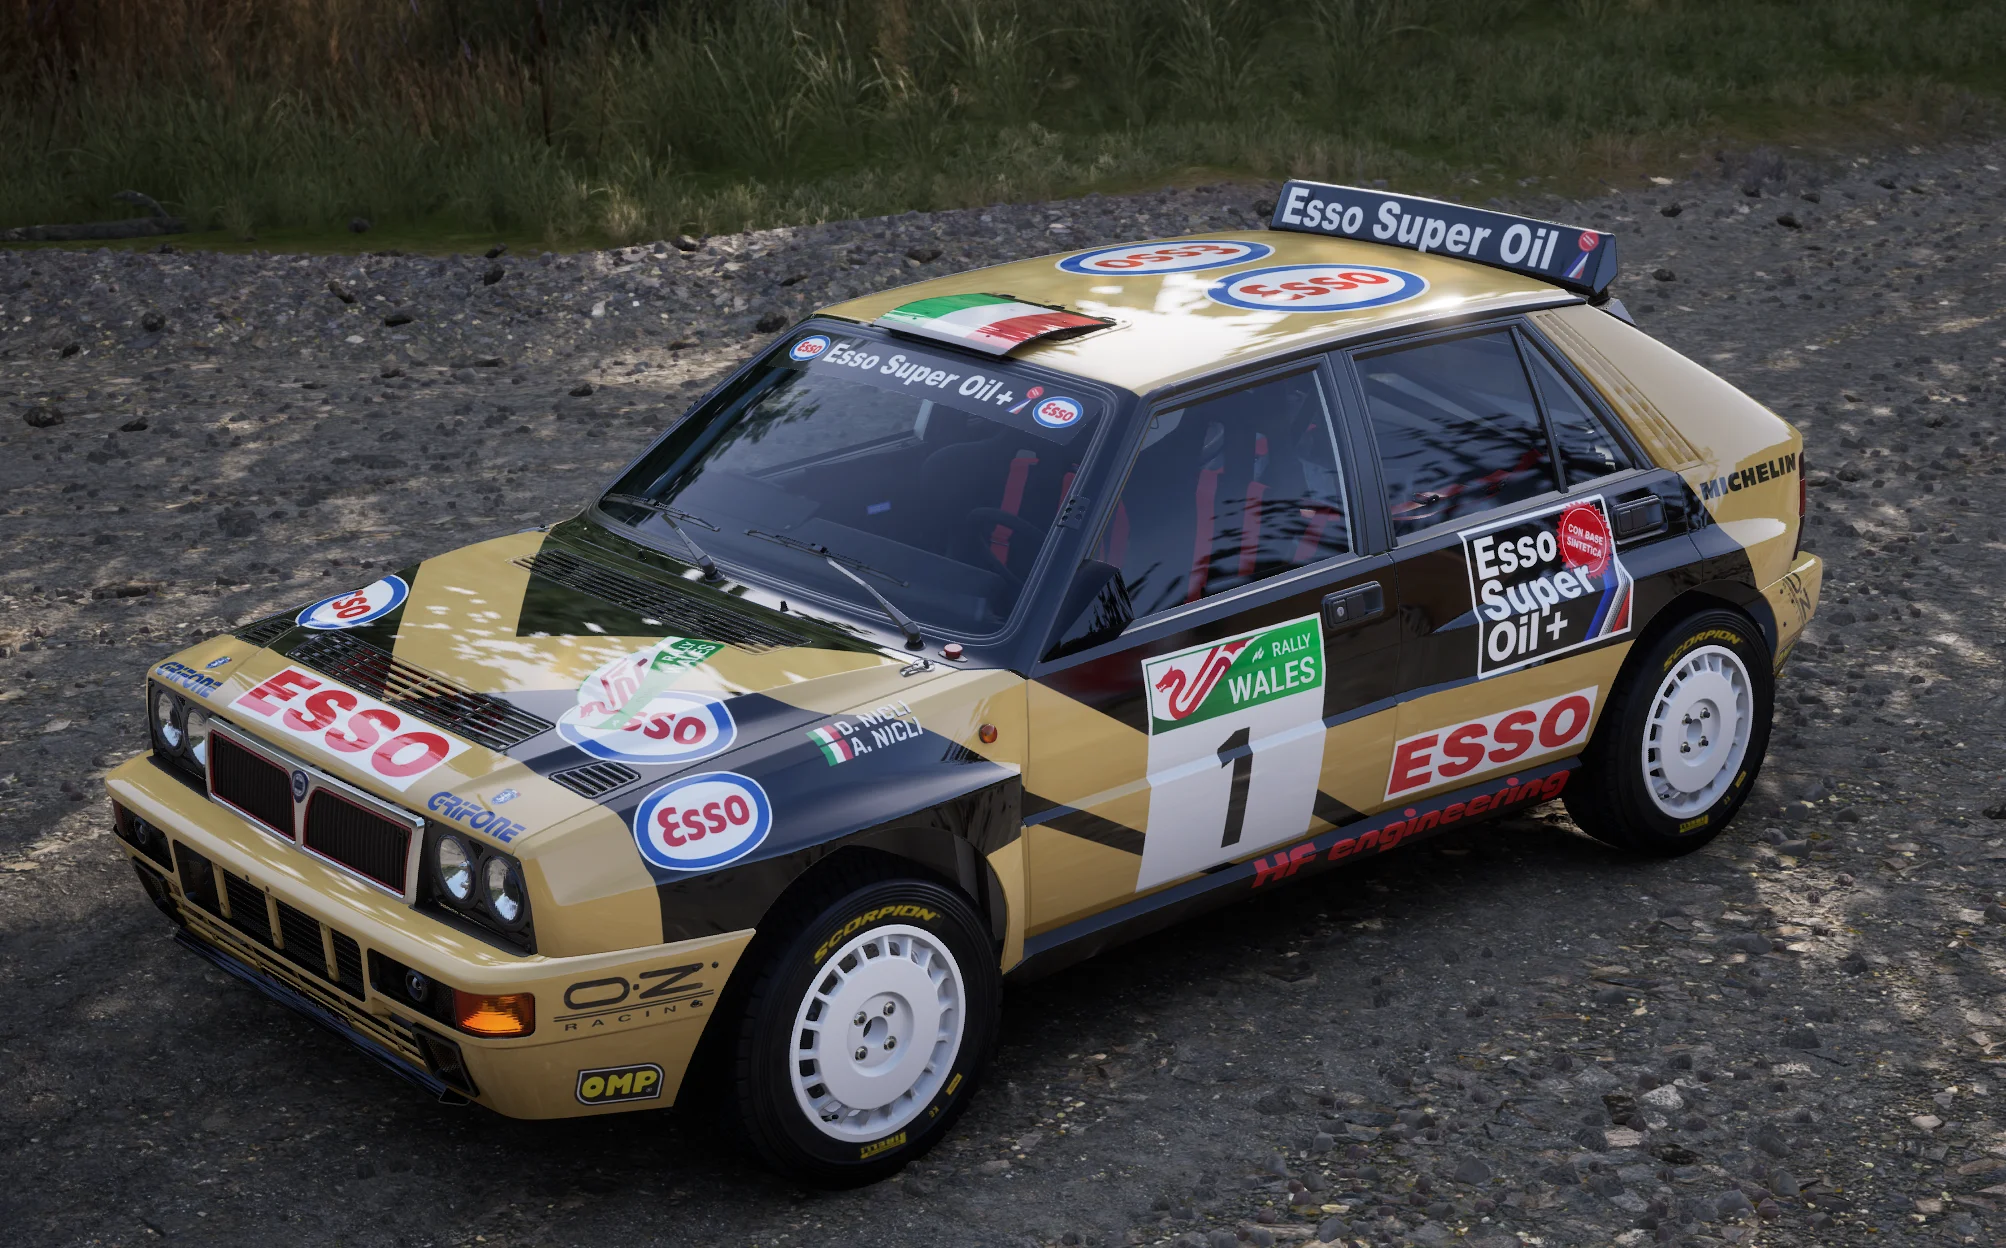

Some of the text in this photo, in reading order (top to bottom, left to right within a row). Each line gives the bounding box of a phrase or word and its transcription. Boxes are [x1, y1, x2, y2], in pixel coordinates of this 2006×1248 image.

[1281, 187, 1559, 271] Esso Super Oil
[822, 343, 880, 370] Esso
[880, 354, 960, 389] Super
[1700, 452, 1797, 500] MICHELIN
[1473, 531, 1557, 580] Esso
[1567, 537, 1602, 558] SINTETICA
[1568, 523, 1604, 546] CON BASE
[1481, 565, 1596, 622] Super
[1272, 632, 1311, 658] RALLY
[1663, 629, 1741, 671] SCORPION
[1228, 656, 1316, 705] WALES
[236, 669, 450, 778] ESSO
[833, 720, 860, 736] D.
[851, 716, 924, 757] A. NICLI
[1387, 695, 1591, 796] ESSO
[1217, 726, 1253, 849] 1
[427, 791, 527, 843] GRIFONE
[1251, 770, 1571, 889] HF engineering
[814, 905, 935, 964] SCORPION
[582, 1070, 658, 1098] OMP
